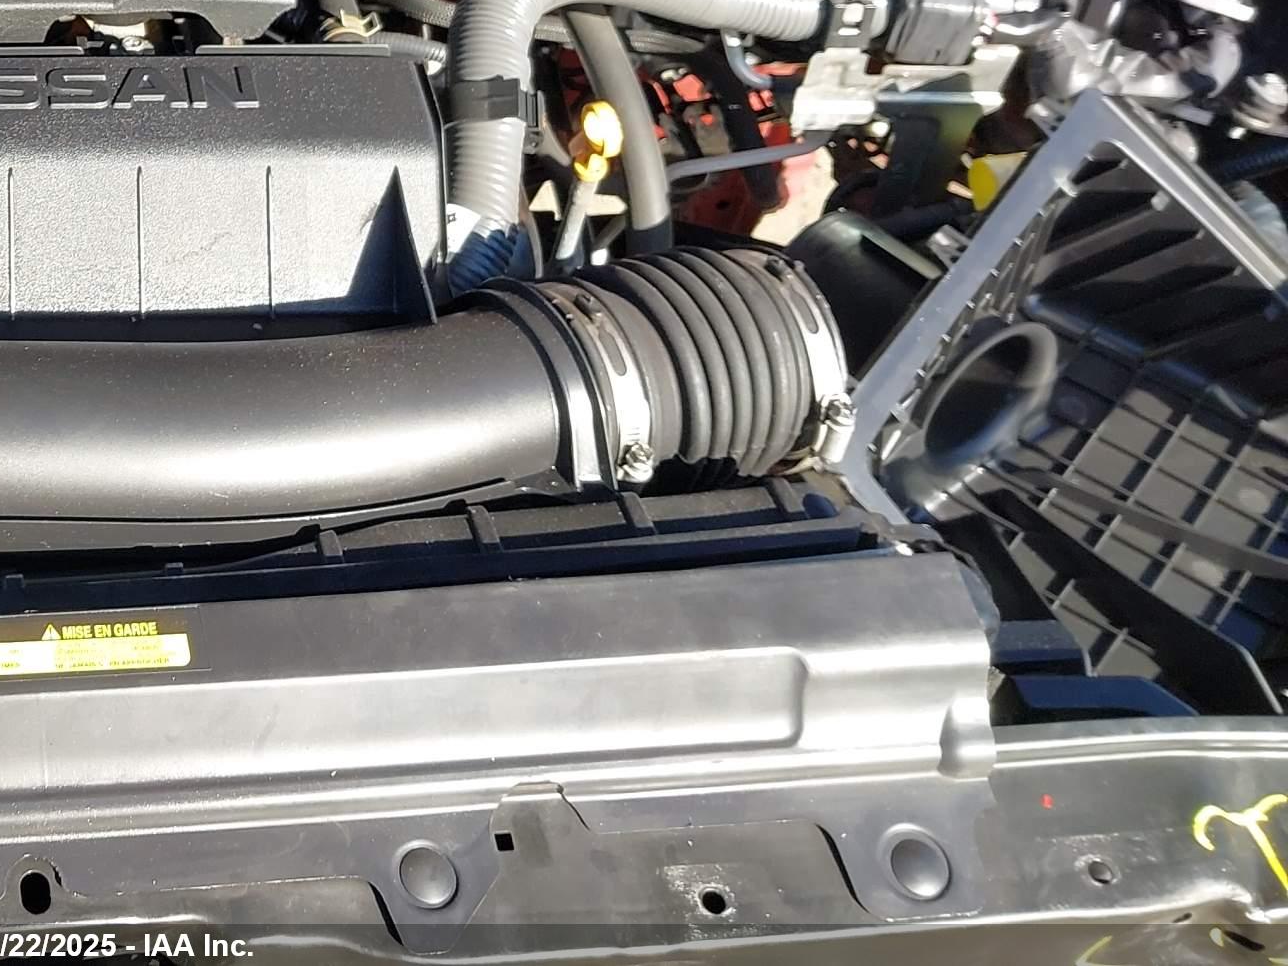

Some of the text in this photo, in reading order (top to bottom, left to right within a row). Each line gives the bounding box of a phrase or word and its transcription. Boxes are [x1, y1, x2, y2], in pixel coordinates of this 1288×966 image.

[62, 621, 158, 640] MISE EN GARDE
